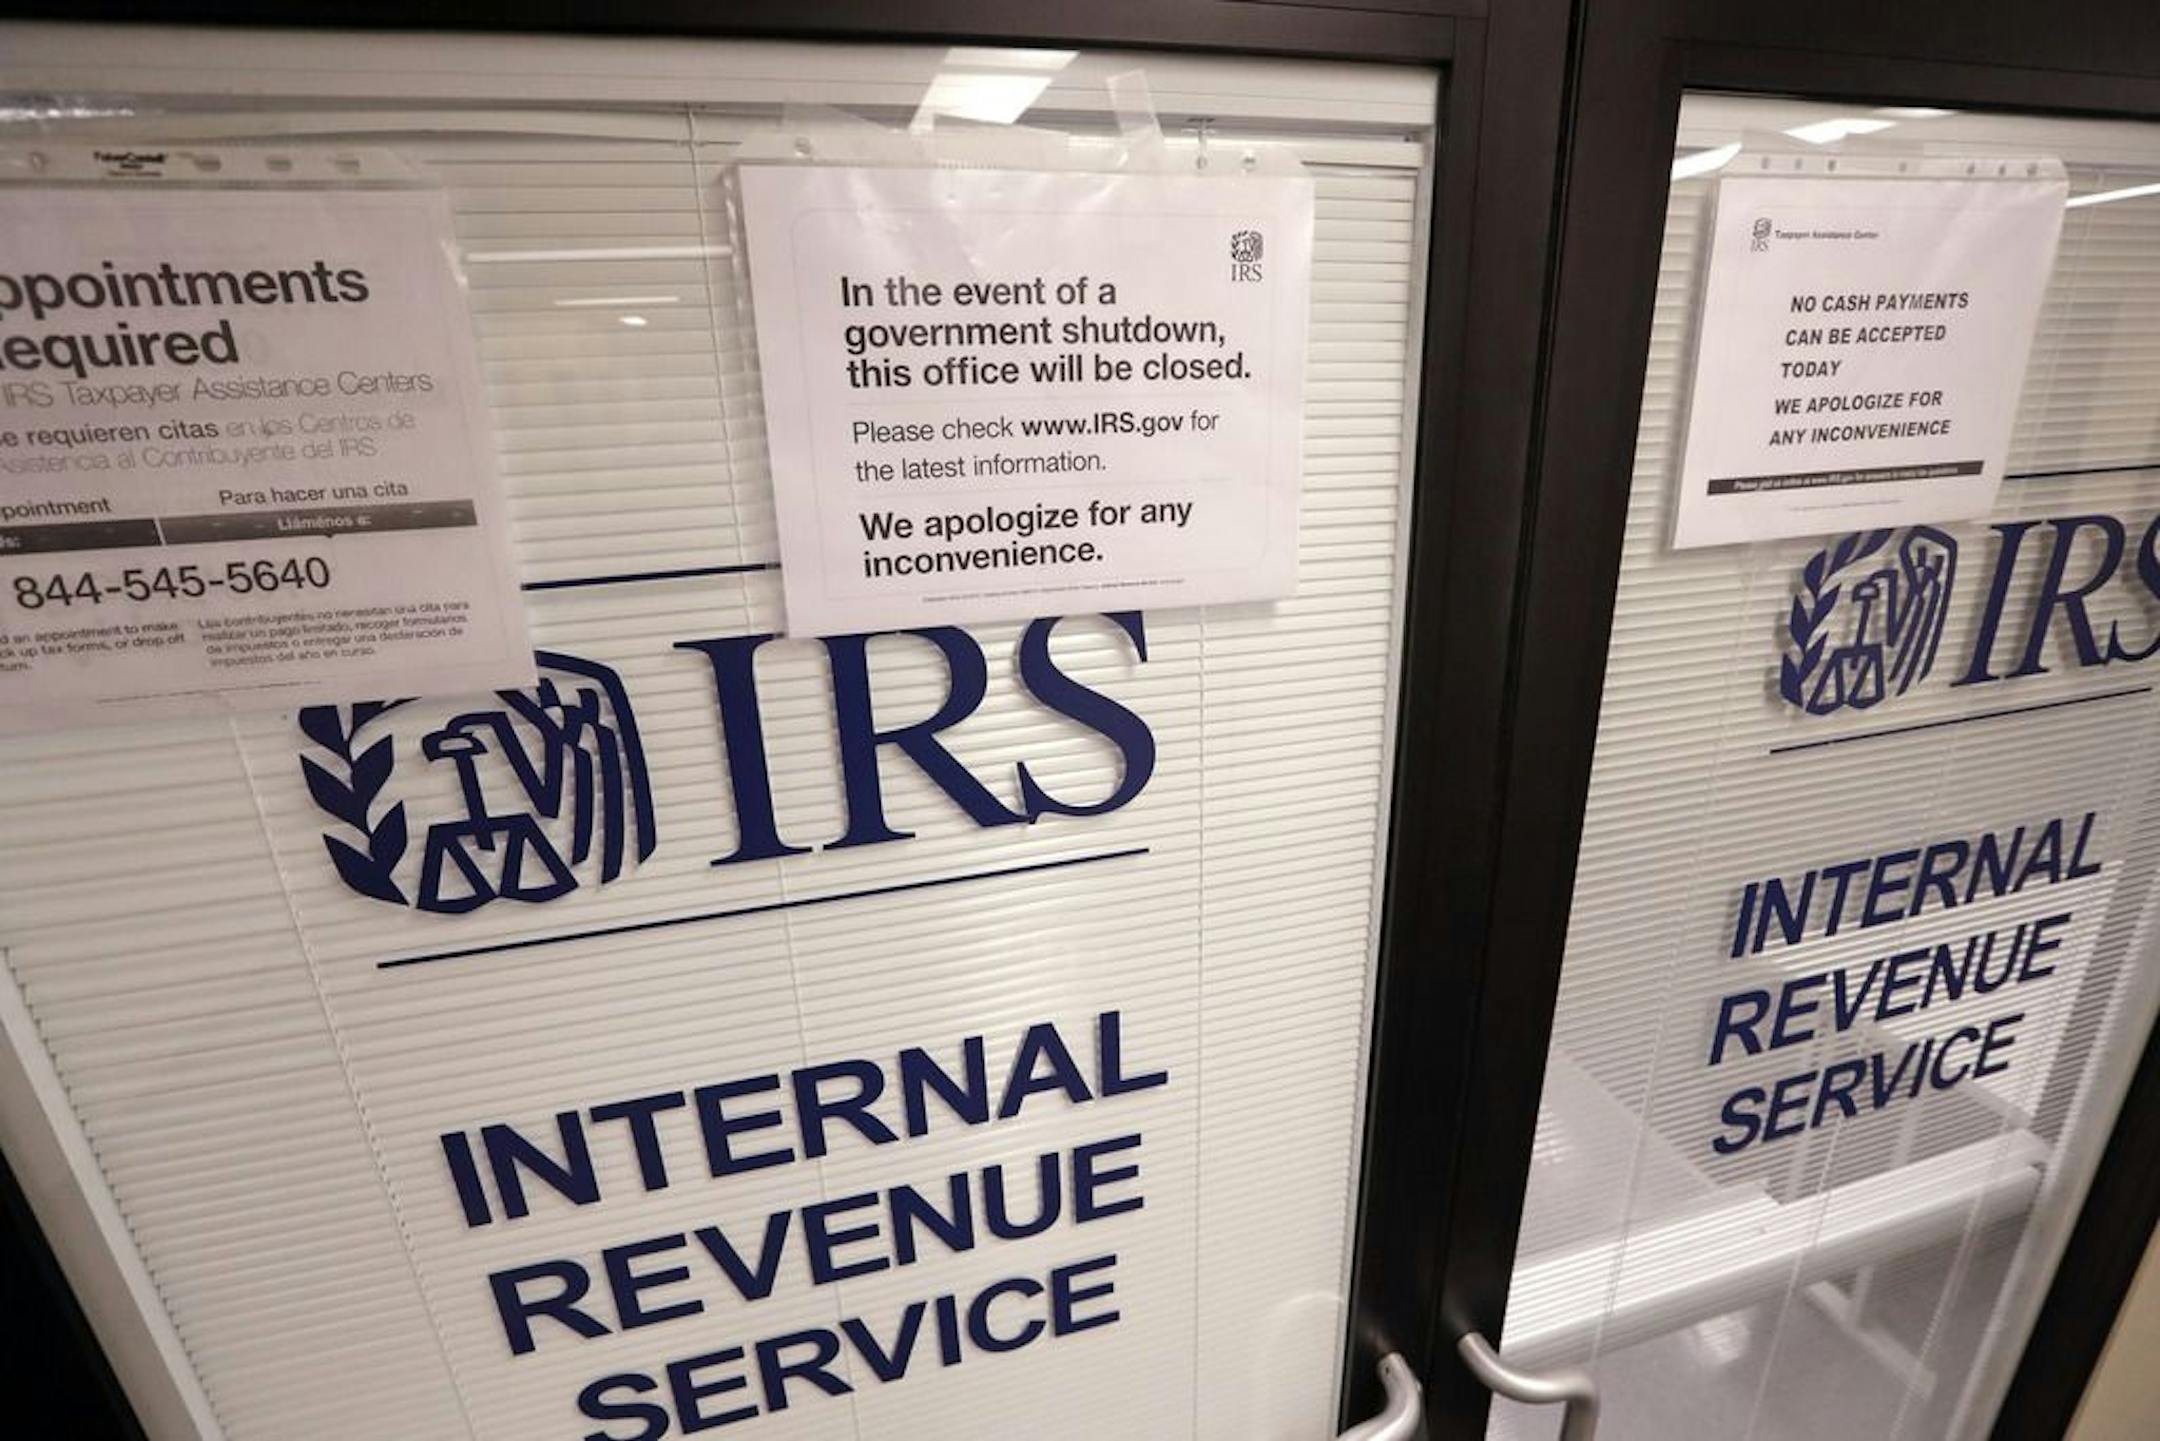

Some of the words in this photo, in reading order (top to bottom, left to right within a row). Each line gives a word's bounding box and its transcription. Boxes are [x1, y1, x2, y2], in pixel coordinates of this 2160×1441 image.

[841, 275, 874, 308] In
[885, 277, 942, 307] the
[953, 275, 1045, 306] event
[1055, 274, 1090, 305] of
[1098, 281, 1118, 305] a
[1231, 264, 1263, 282] IRS
[1790, 295, 1817, 314] NO
[1821, 294, 1871, 313] CASH
[1875, 292, 1970, 312] PAYMENTS
[0, 319, 240, 378] equired
[844, 317, 1052, 356] government
[1061, 314, 1227, 348] shutdown,
[1785, 328, 1822, 347] CAN
[1828, 327, 1852, 345] BE
[1856, 324, 1947, 344] ACCEPTED
[2, 381, 54, 409] IRS
[59, 380, 181, 409] Taxpayer
[192, 374, 331, 401] Assistance
[337, 370, 434, 396] Centers
[846, 358, 912, 390] this
[923, 355, 1020, 387] office
[1030, 353, 1084, 384] will
[1094, 353, 1134, 382] be
[1142, 350, 1252, 382] closed.
[1781, 360, 1841, 379] TODAY
[1774, 397, 1802, 415] WE
[1806, 392, 1904, 414] APOLOGIZE
[1909, 390, 1943, 408] FOR
[0, 431, 19, 448] e
[26, 422, 151, 449] requieren
[158, 418, 220, 440] citas
[226, 421, 256, 437] en
[299, 411, 383, 434] Centros
[387, 409, 417, 431] de
[852, 420, 935, 444] Please
[941, 414, 1014, 441] check
[1020, 412, 1184, 438] www.IRS.gov
[1190, 410, 1220, 432] for
[1768, 428, 1804, 446] ANY
[1812, 419, 1952, 444] INCONVENIENCE
[118, 449, 136, 470] al
[143, 443, 296, 469] Contribuyente
[302, 439, 334, 460] del
[340, 436, 378, 458] IRS
[856, 459, 895, 482] the
[901, 455, 966, 480] latest
[972, 450, 1107, 476] information.
[218, 488, 267, 506] Para
[271, 486, 326, 503] hacer
[332, 485, 368, 500] una
[373, 480, 409, 498] cita
[860, 511, 914, 542] We
[924, 501, 1079, 543] apologize
[1088, 500, 1131, 529] for
[1140, 500, 1194, 528] any
[863, 539, 1104, 579] inconvenience.
[13, 555, 331, 610] 844-545-5640
[35, 625, 122, 643] appointment
[124, 625, 139, 635] to
[673, 610, 1156, 866] IRS
[1731, 812, 2101, 958] INTERNAL
[1707, 911, 2073, 1066] REVENUE
[1712, 1013, 2026, 1155] SERVICE
[440, 1010, 1168, 1229] INTERNAL
[488, 1132, 1145, 1357] REVENUE
[577, 1253, 1121, 1441] SERVICE
